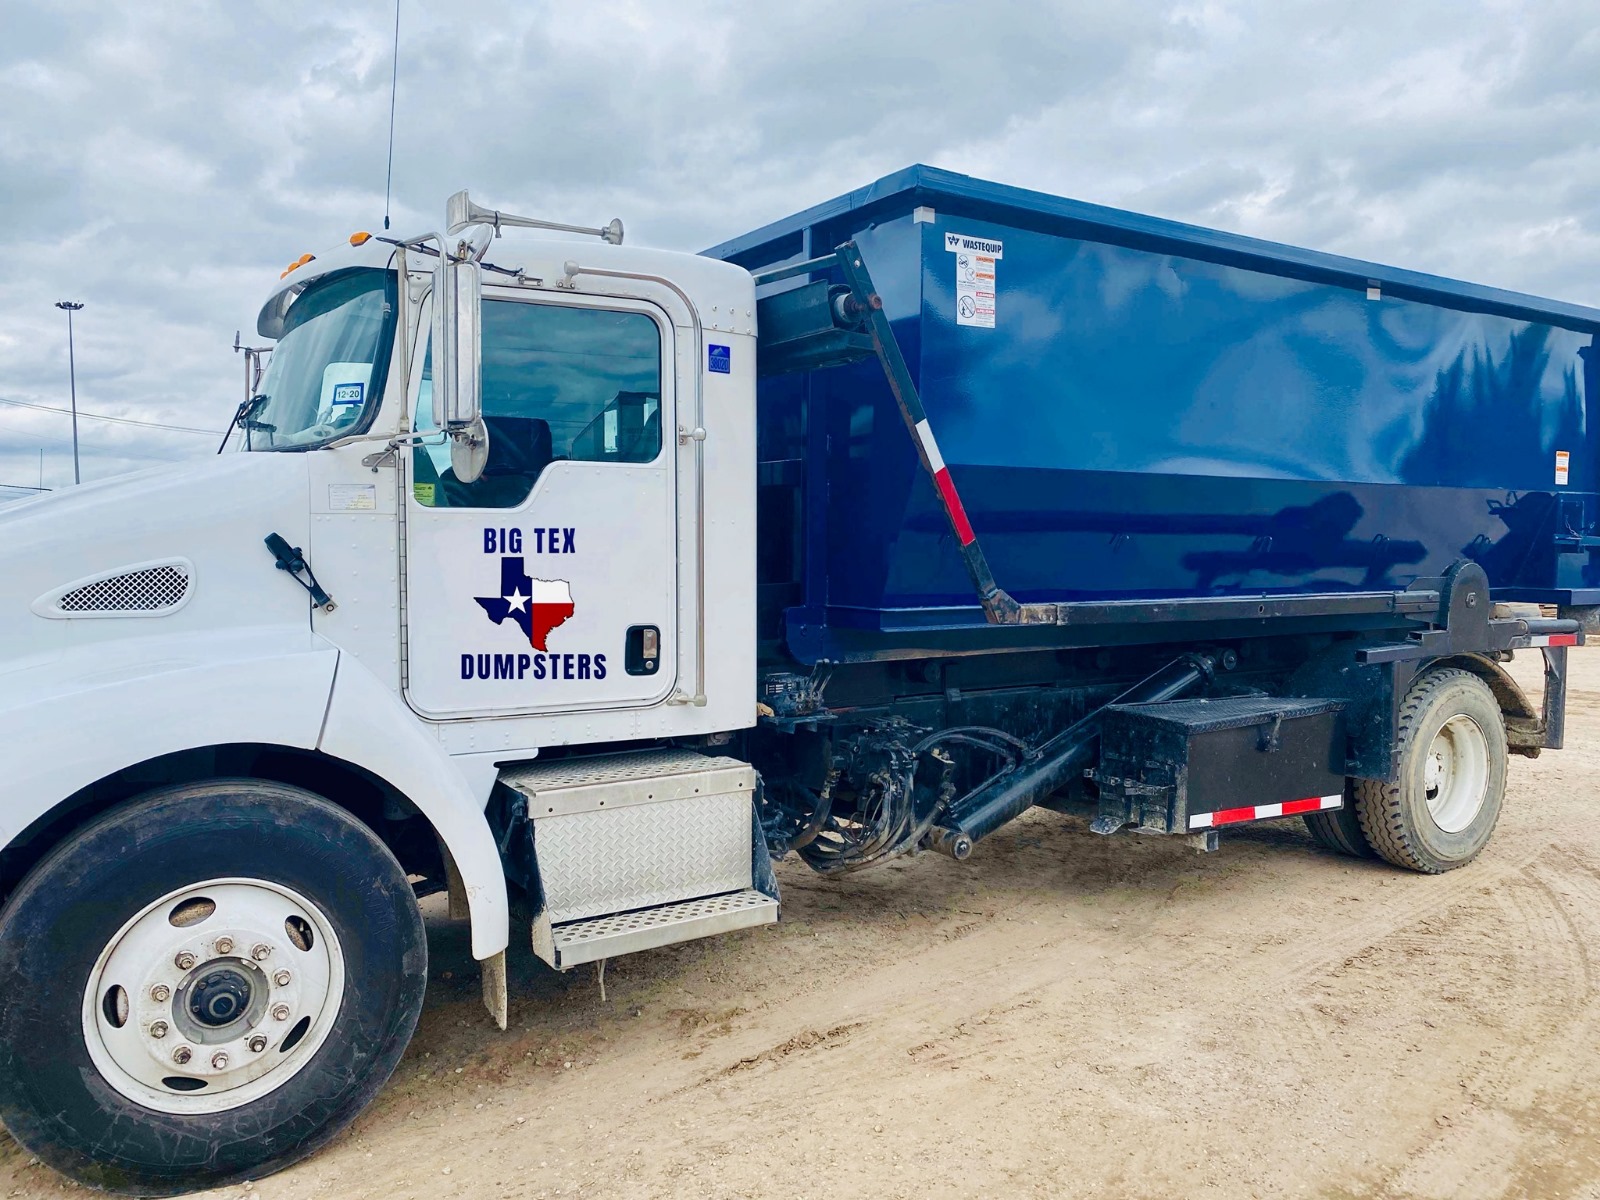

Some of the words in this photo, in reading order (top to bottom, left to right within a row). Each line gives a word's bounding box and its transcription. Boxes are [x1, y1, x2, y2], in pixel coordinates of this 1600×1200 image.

[962, 238, 1002, 253] WASTEQUIP
[483, 527, 523, 554] BIG
[533, 527, 576, 554] TEX
[460, 653, 607, 680] DUMPSTERS
